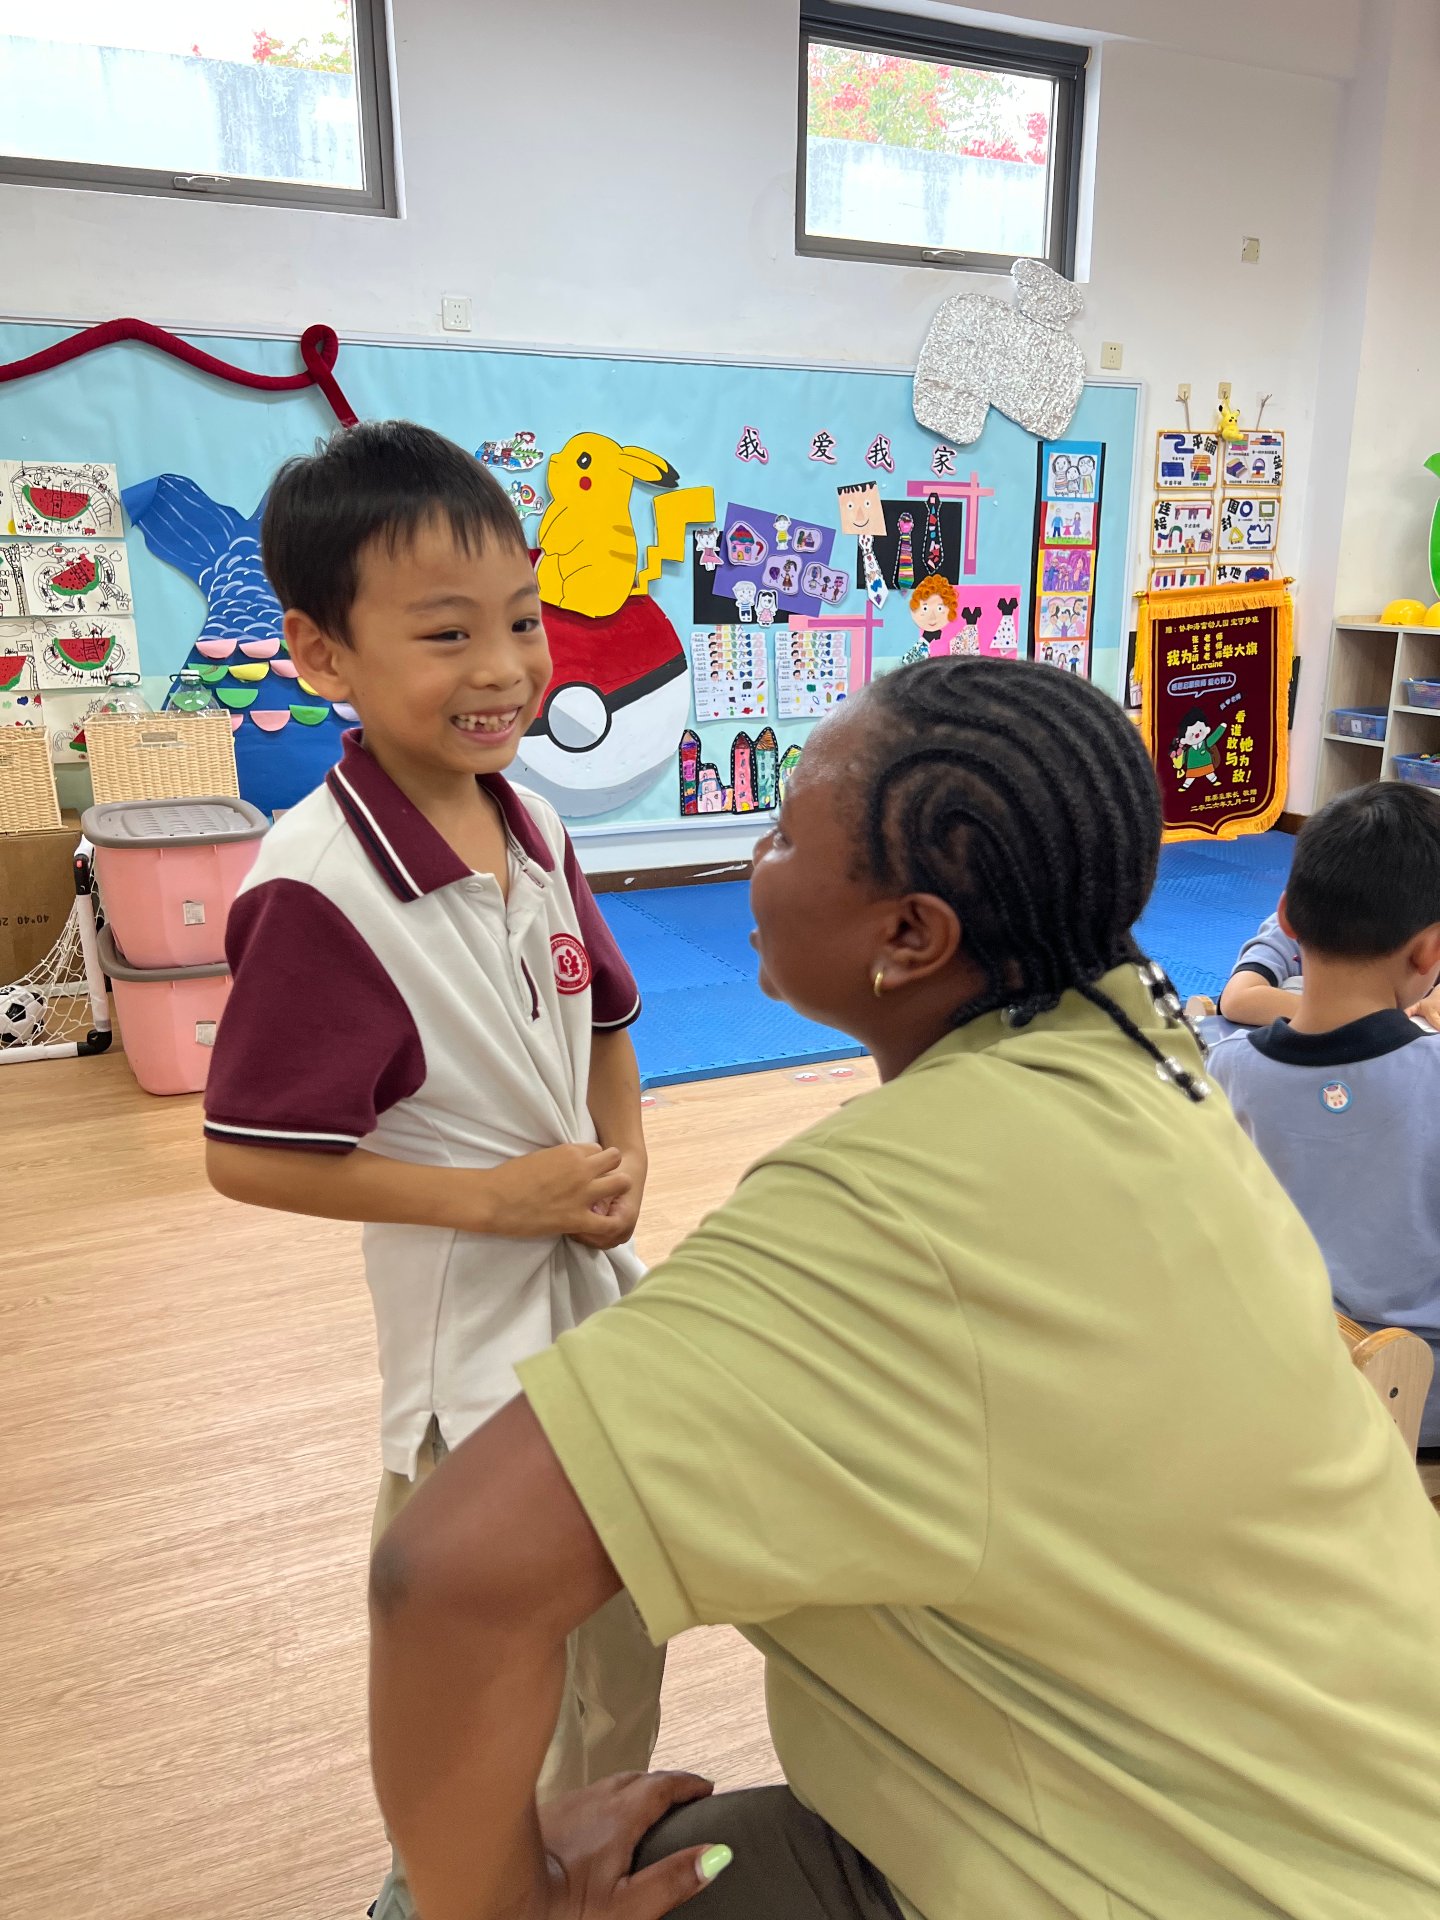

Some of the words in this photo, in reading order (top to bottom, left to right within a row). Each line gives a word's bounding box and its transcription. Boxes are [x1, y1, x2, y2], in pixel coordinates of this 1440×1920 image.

[738, 428, 955, 474] 我爱我家
[1154, 501, 1171, 531] 连接
[1221, 499, 1240, 532] 围封
[1216, 565, 1242, 580] 其他
[1167, 649, 1192, 666] 我为
[1222, 641, 1258, 658] 举大旗
[1192, 660, 1223, 671] Lorraine
